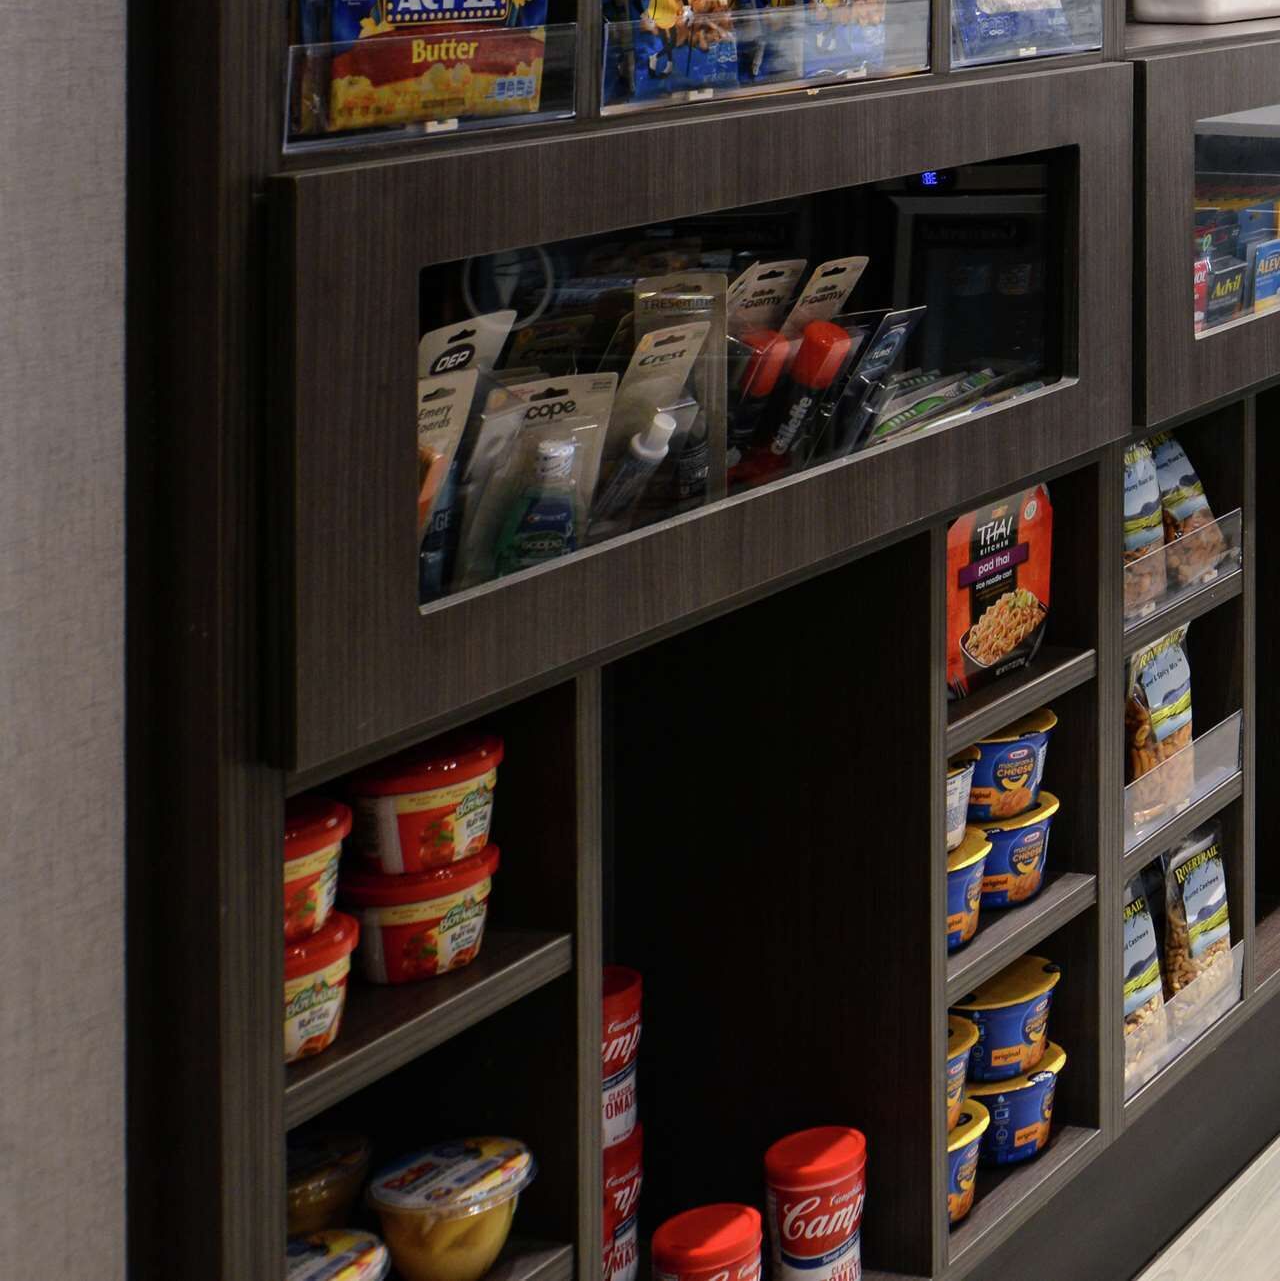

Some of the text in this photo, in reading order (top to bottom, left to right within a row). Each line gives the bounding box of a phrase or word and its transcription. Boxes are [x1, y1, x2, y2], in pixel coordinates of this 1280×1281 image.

[412, 38, 478, 63] Butter
[801, 289, 846, 307] Foamy
[1212, 274, 1242, 299] Advil
[435, 350, 470, 372] DEP
[639, 349, 687, 367] Crest
[418, 420, 451, 434] oards
[976, 516, 1013, 547] THAI
[978, 558, 994, 577] pad
[1175, 843, 1219, 885] RIVERTRAIL
[605, 1092, 636, 1120] OMAT
